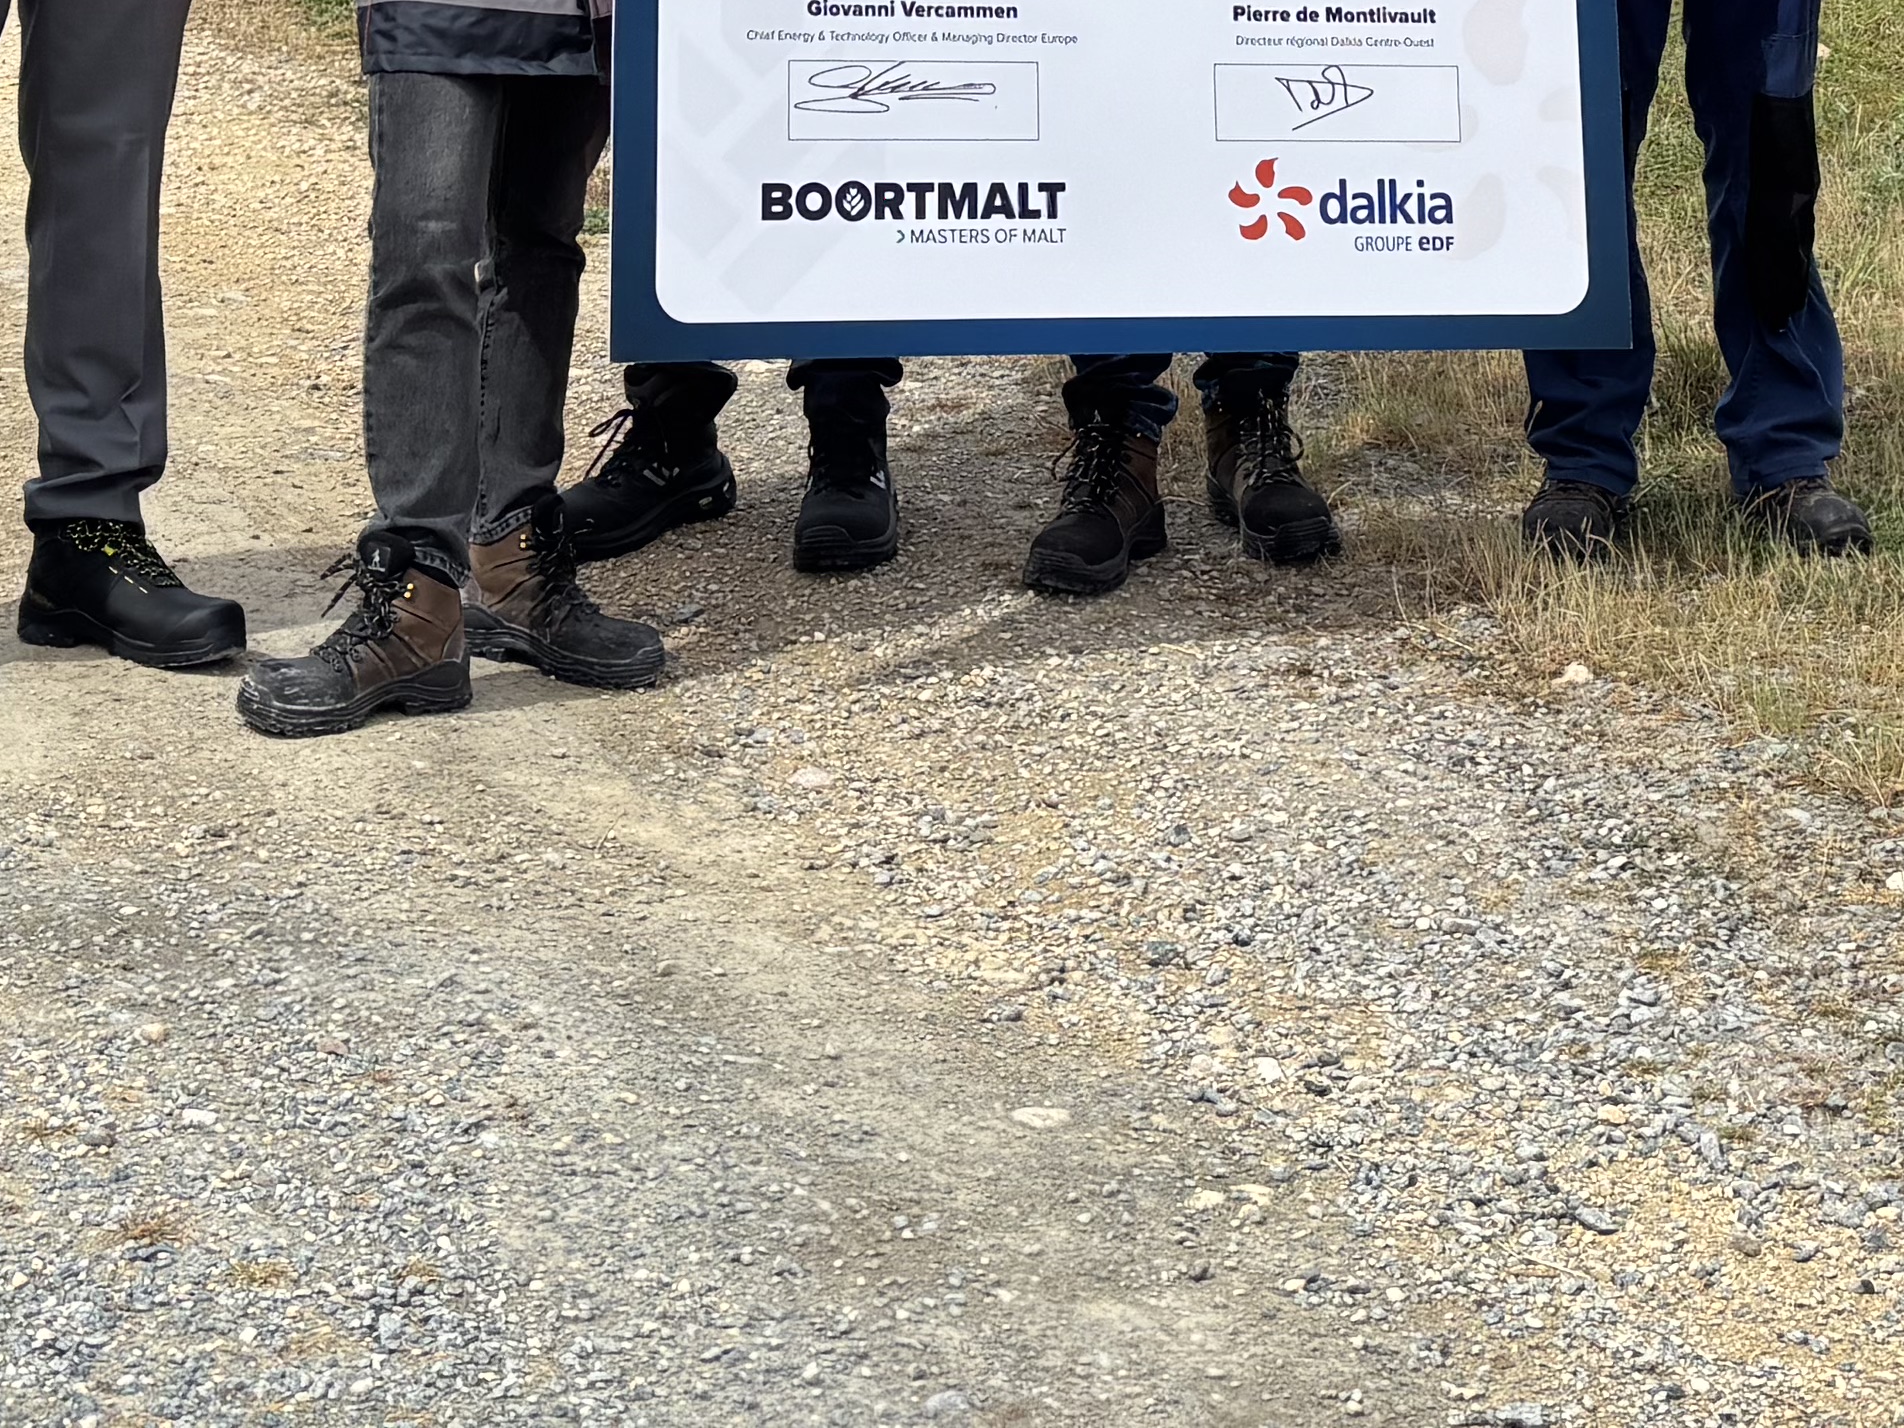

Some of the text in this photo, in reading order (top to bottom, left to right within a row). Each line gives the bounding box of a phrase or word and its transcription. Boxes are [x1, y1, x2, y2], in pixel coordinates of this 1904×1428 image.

[807, 0, 1019, 19] Giovanni Vercammen
[1233, 5, 1437, 24] Pierre de Montlivault
[777, 30, 815, 43] Energy
[818, 31, 827, 41] &
[829, 30, 890, 44] Technology
[892, 32, 928, 43] Officer
[930, 32, 939, 43] &
[996, 33, 1039, 45] Director
[1041, 33, 1078, 46] Europe
[1235, 35, 1284, 47] Directeur
[761, 180, 1066, 222] BOORTMALT
[1319, 178, 1454, 225] dalkia
[910, 228, 1067, 244] MASTERS OF MALT
[1354, 235, 1413, 252] GROUPE
